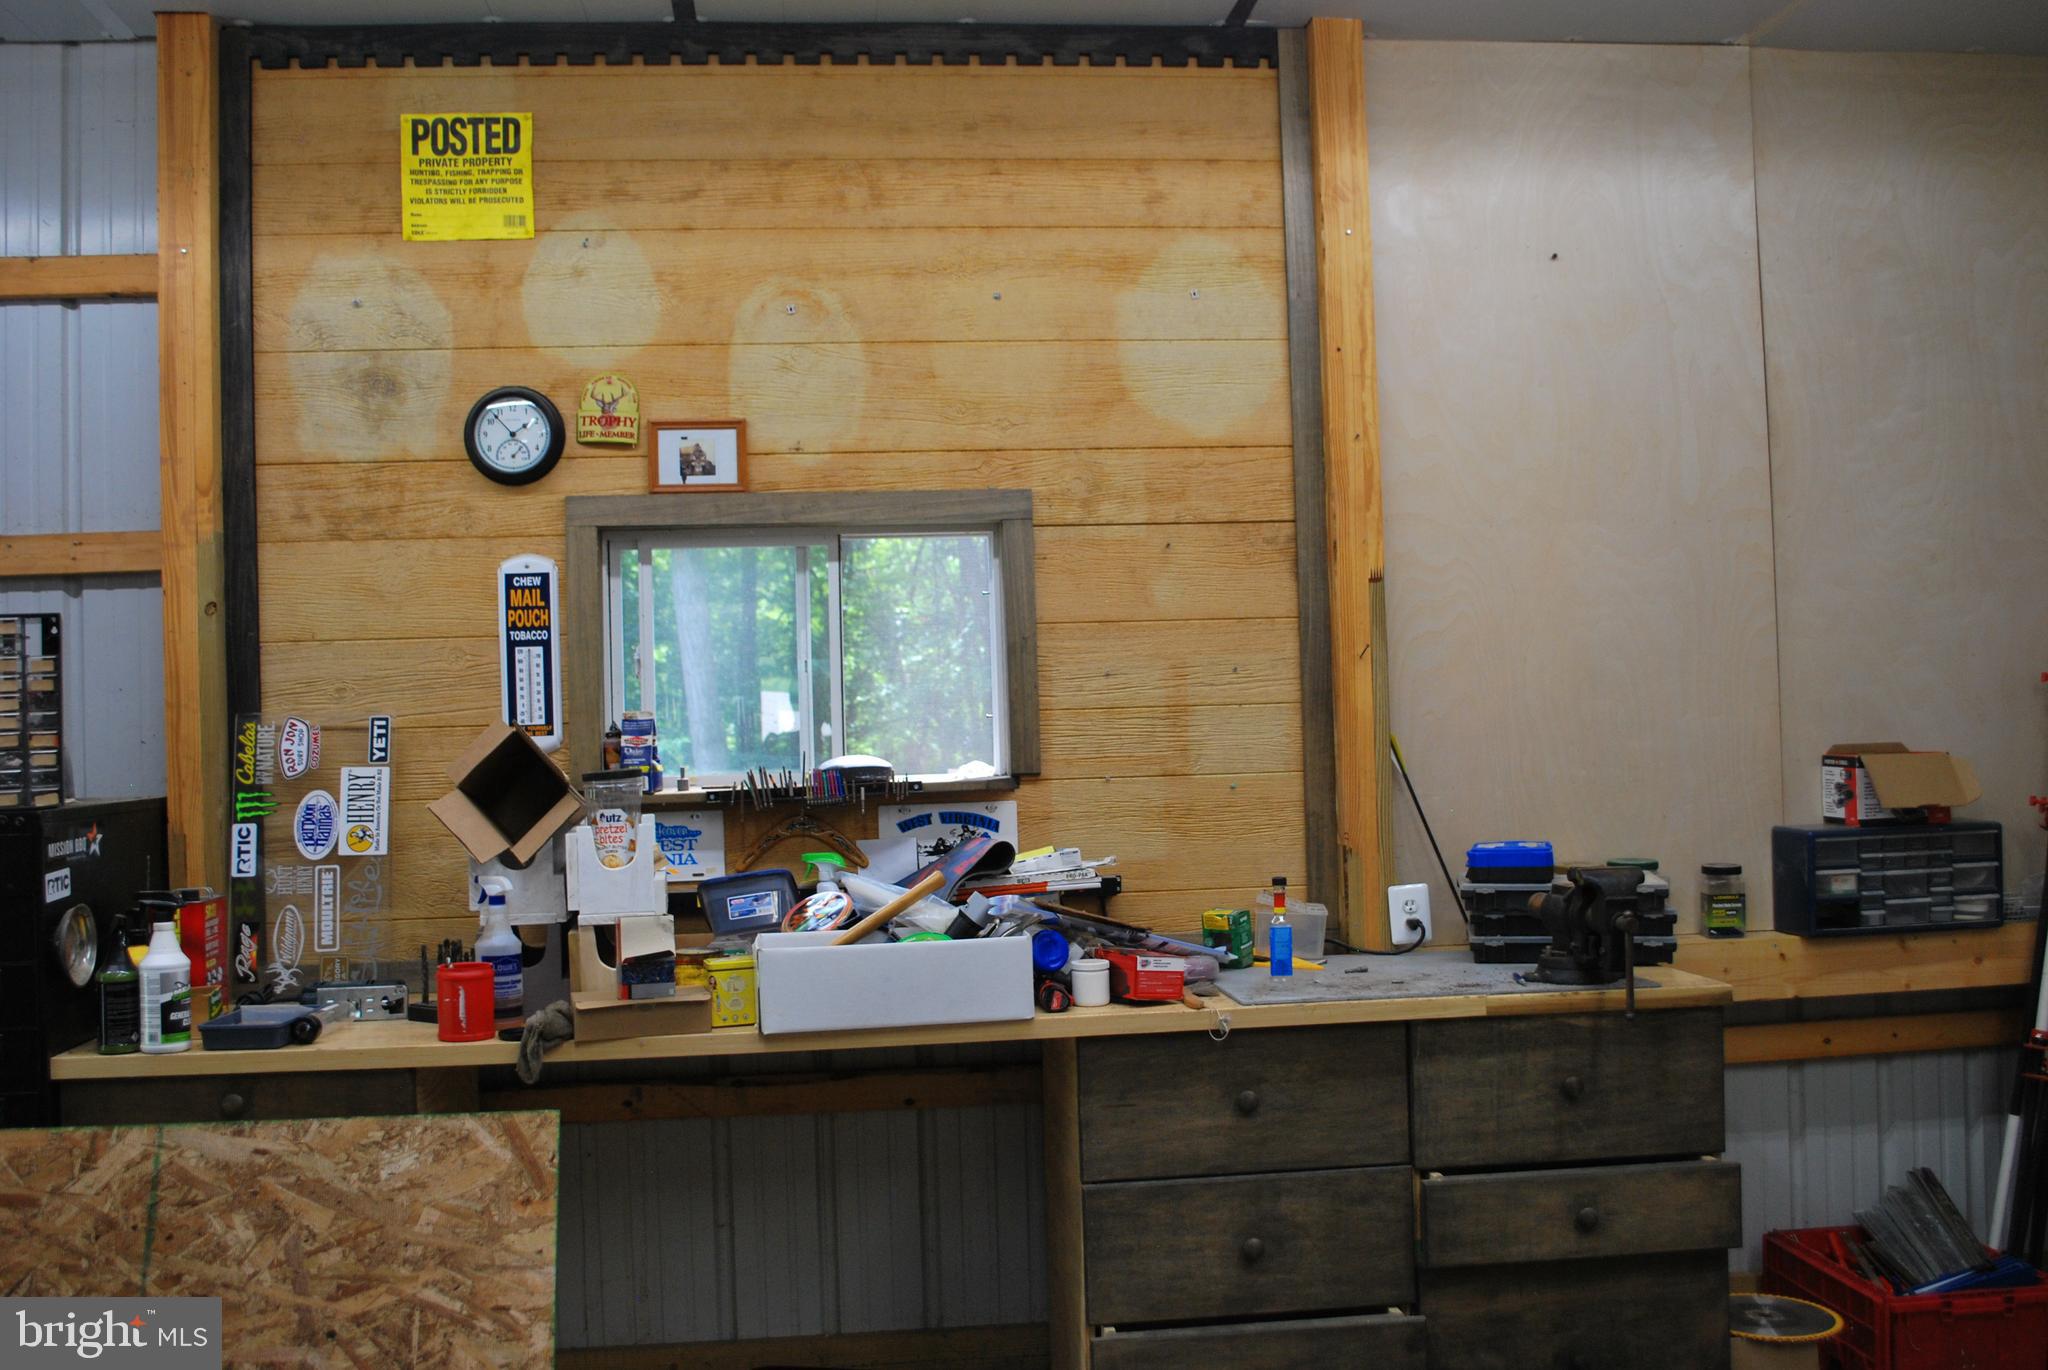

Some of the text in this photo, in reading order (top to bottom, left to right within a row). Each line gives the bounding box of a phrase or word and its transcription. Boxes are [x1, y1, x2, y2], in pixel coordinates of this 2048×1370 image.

[411, 117, 521, 156] POSTED
[418, 157, 513, 168] PRIVATE PROPERTY
[409, 169, 443, 177] HUNTING,
[477, 168, 511, 176] TRAPPING
[410, 178, 457, 186] TRESPASSING
[409, 196, 524, 205] VIOLATORS WILL BE PROSECUTED
[435, 188, 466, 196] STRICTLY
[469, 187, 507, 195] FORBIDDEN
[580, 415, 637, 428] TROPHY
[578, 430, 636, 440] LIFE MEMBER
[513, 576, 541, 587] CHEW
[510, 589, 545, 607] MAIL
[507, 609, 549, 628] POUCH
[509, 630, 549, 641] TOBACCO
[284, 718, 298, 772] RON JON
[310, 725, 320, 769] COZUMEL
[373, 720, 385, 760] YETI
[236, 722, 256, 785] Cabela's
[346, 774, 375, 824] HENRY
[606, 814, 622, 823] utz
[896, 811, 1000, 833] WEST VIRGINIA
[594, 823, 628, 836] pretzel
[48, 840, 74, 857] MISSION
[599, 834, 624, 845] bites
[660, 839, 698, 852] EST
[237, 827, 251, 873] RTIC
[48, 874, 69, 896] RTIC
[277, 865, 293, 894] HUNT
[297, 865, 313, 894] HENRY
[321, 872, 334, 945] MOULTRIE
[235, 923, 257, 982] Rage
